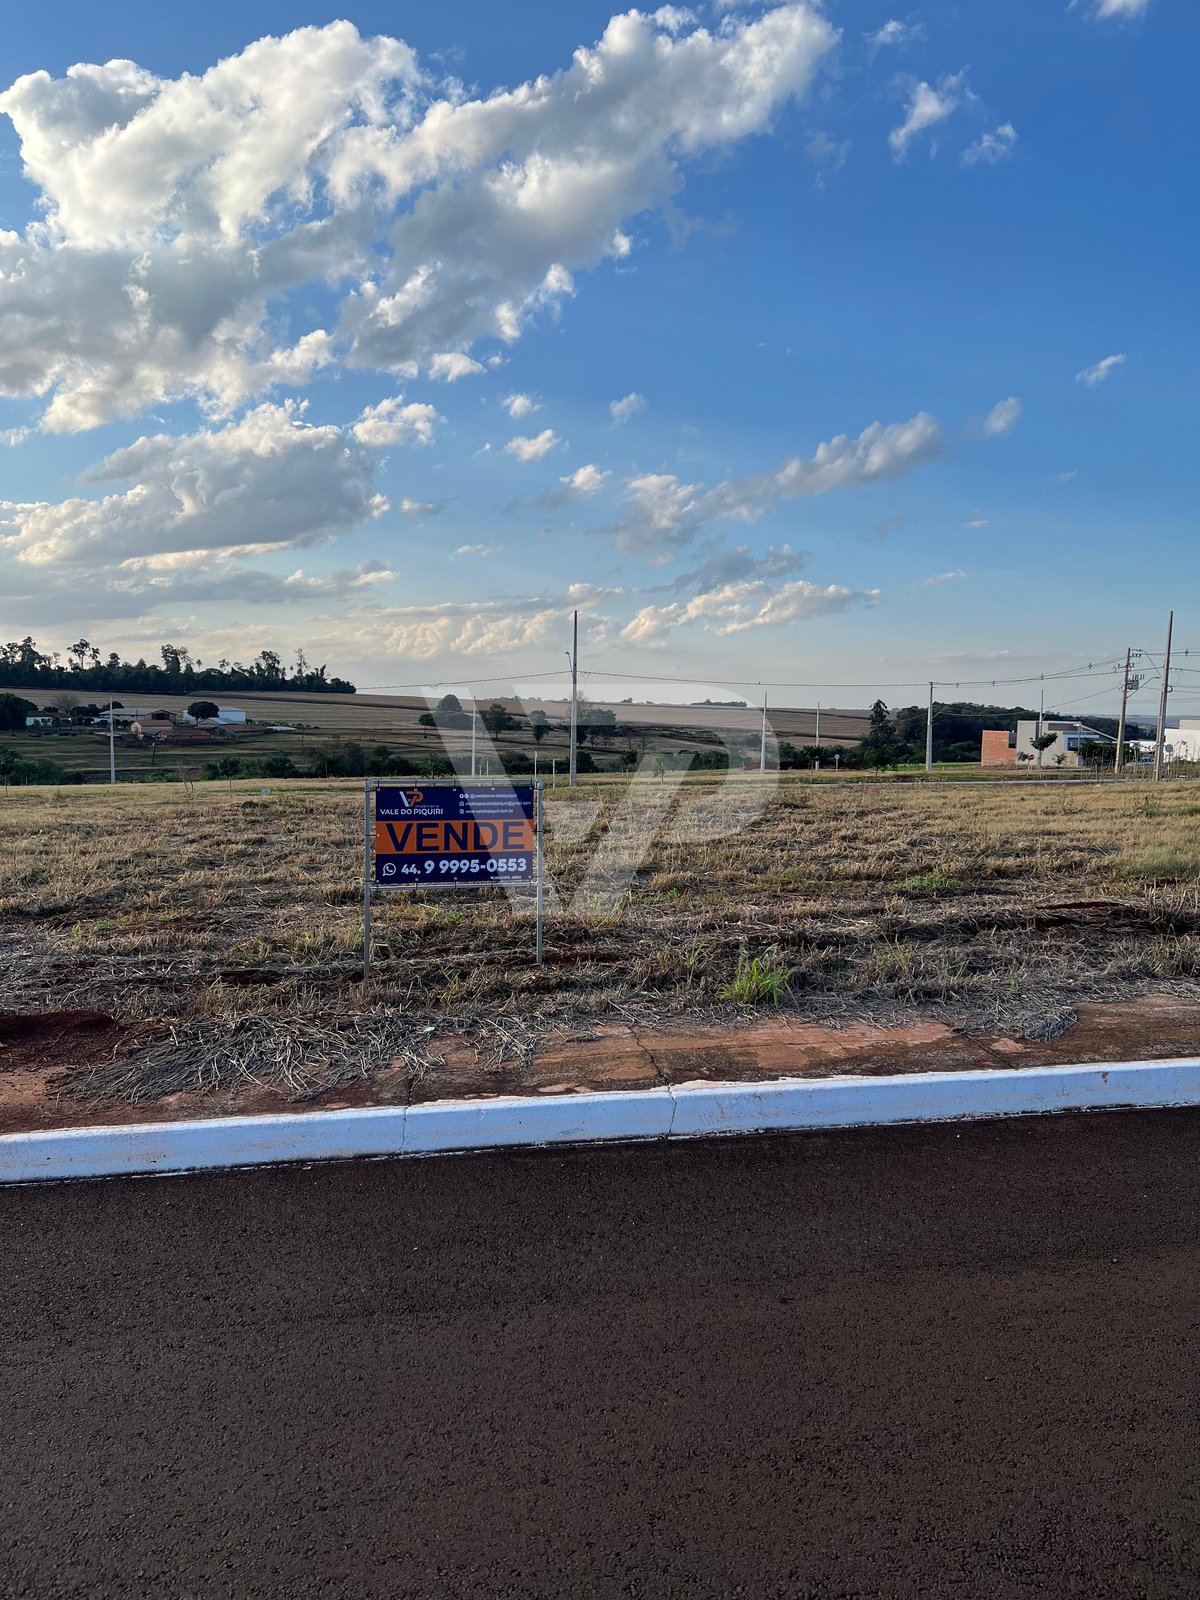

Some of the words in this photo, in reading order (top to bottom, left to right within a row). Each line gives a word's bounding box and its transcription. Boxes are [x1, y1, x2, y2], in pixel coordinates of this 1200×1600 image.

[413, 808, 443, 816] PIQUIRI
[386, 821, 525, 852] VENDE
[401, 863, 421, 875] 44.
[424, 860, 435, 874] 9
[439, 858, 527, 874] 9995-0553
